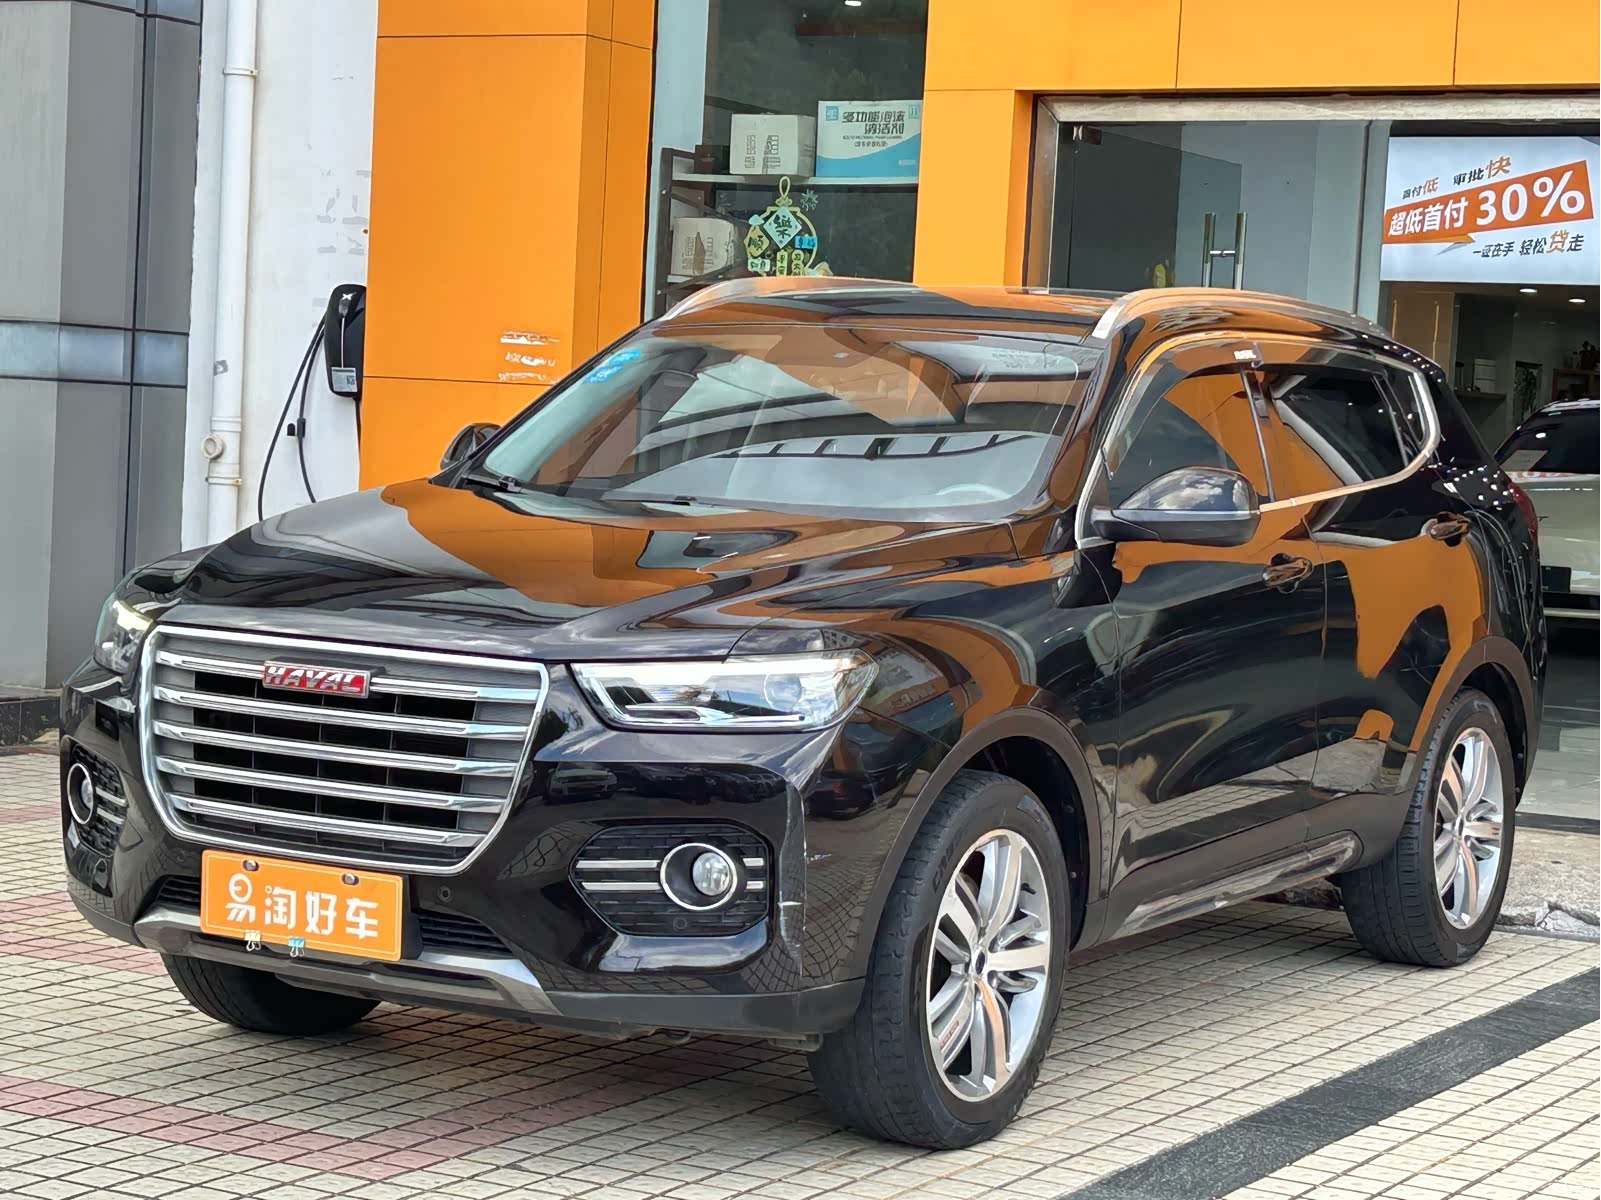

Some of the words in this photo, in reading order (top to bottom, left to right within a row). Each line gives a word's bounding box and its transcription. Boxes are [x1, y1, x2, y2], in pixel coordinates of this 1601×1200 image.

[1453, 156, 1511, 186] 审批快
[1388, 197, 1468, 236] 超低首付
[1476, 170, 1585, 226] 30%
[1519, 229, 1585, 256] 轻松贷走
[265, 666, 361, 692] HAVAL
[225, 872, 379, 939] 易淘好车
